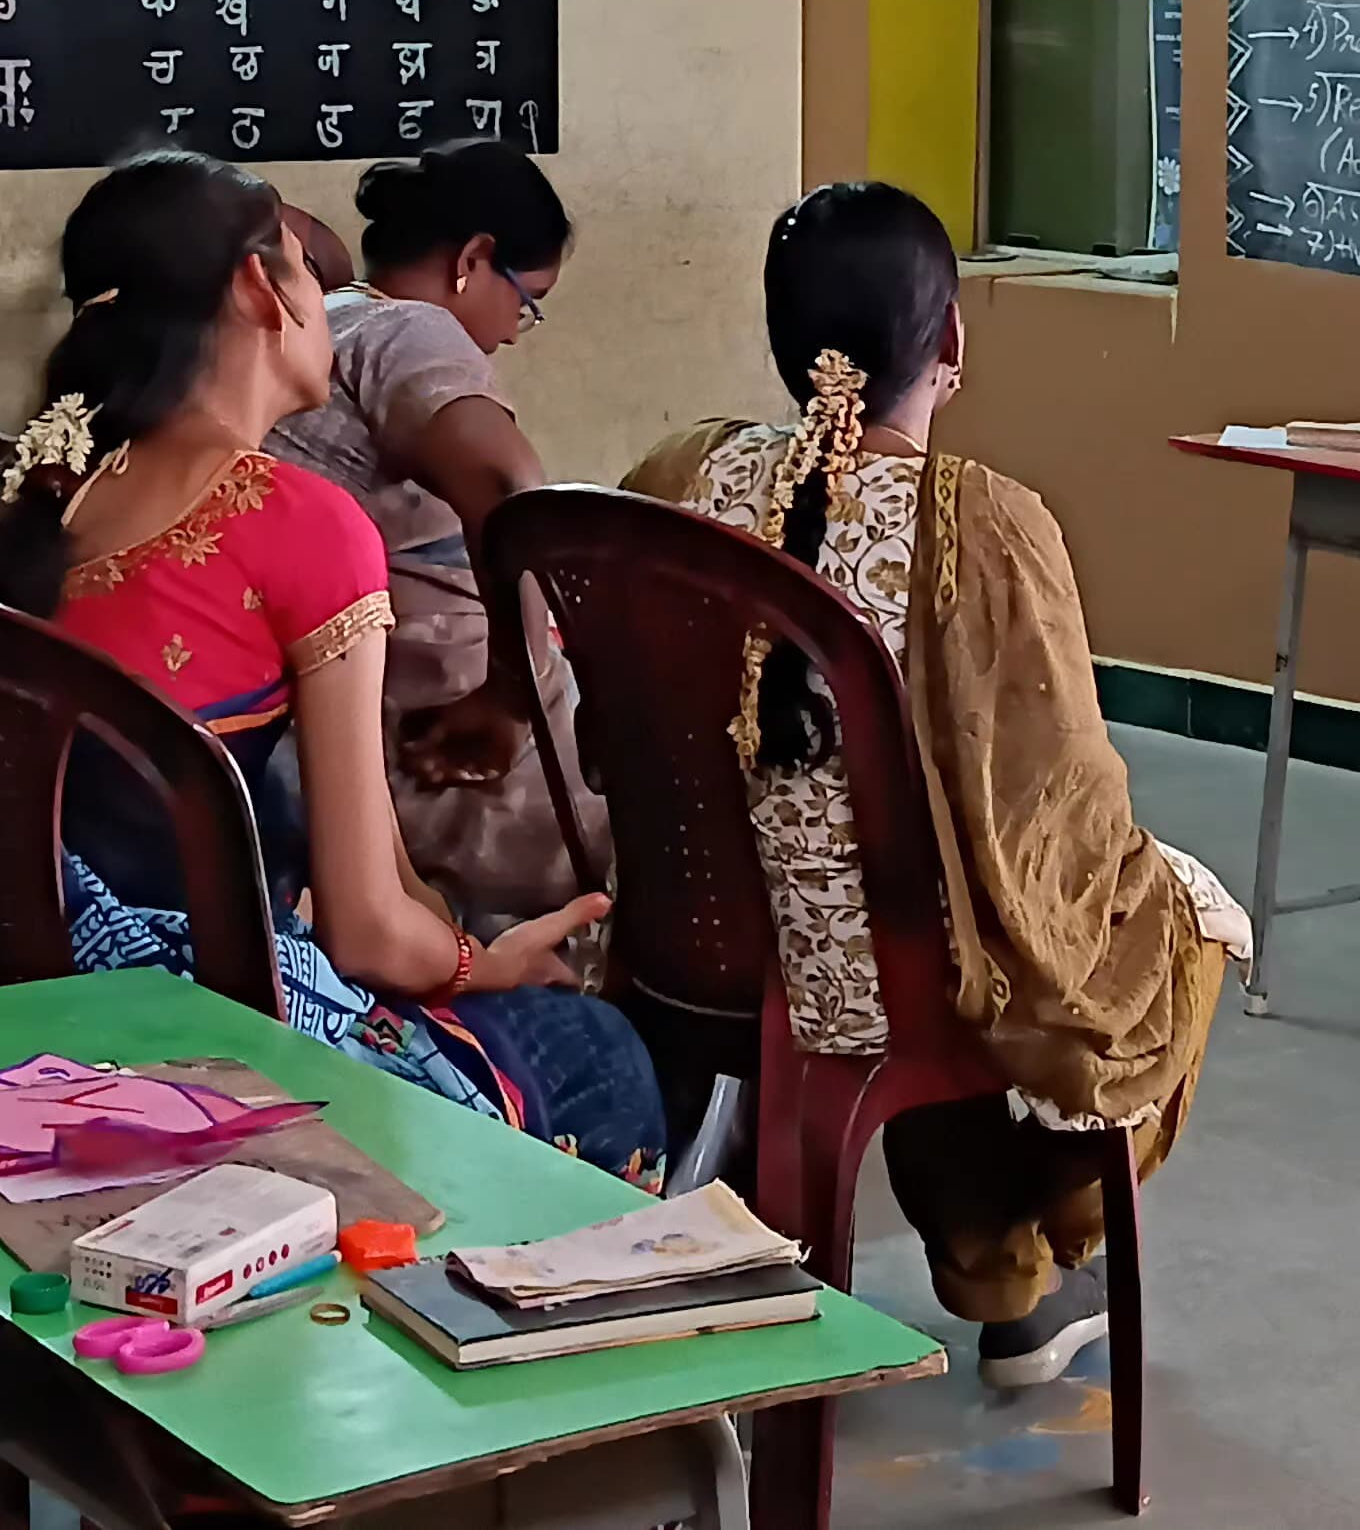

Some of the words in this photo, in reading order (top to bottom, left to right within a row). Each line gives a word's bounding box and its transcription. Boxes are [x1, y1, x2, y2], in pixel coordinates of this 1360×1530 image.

[143, 50, 183, 84] च
[318, 44, 350, 77] ज
[317, 104, 354, 148] ड
